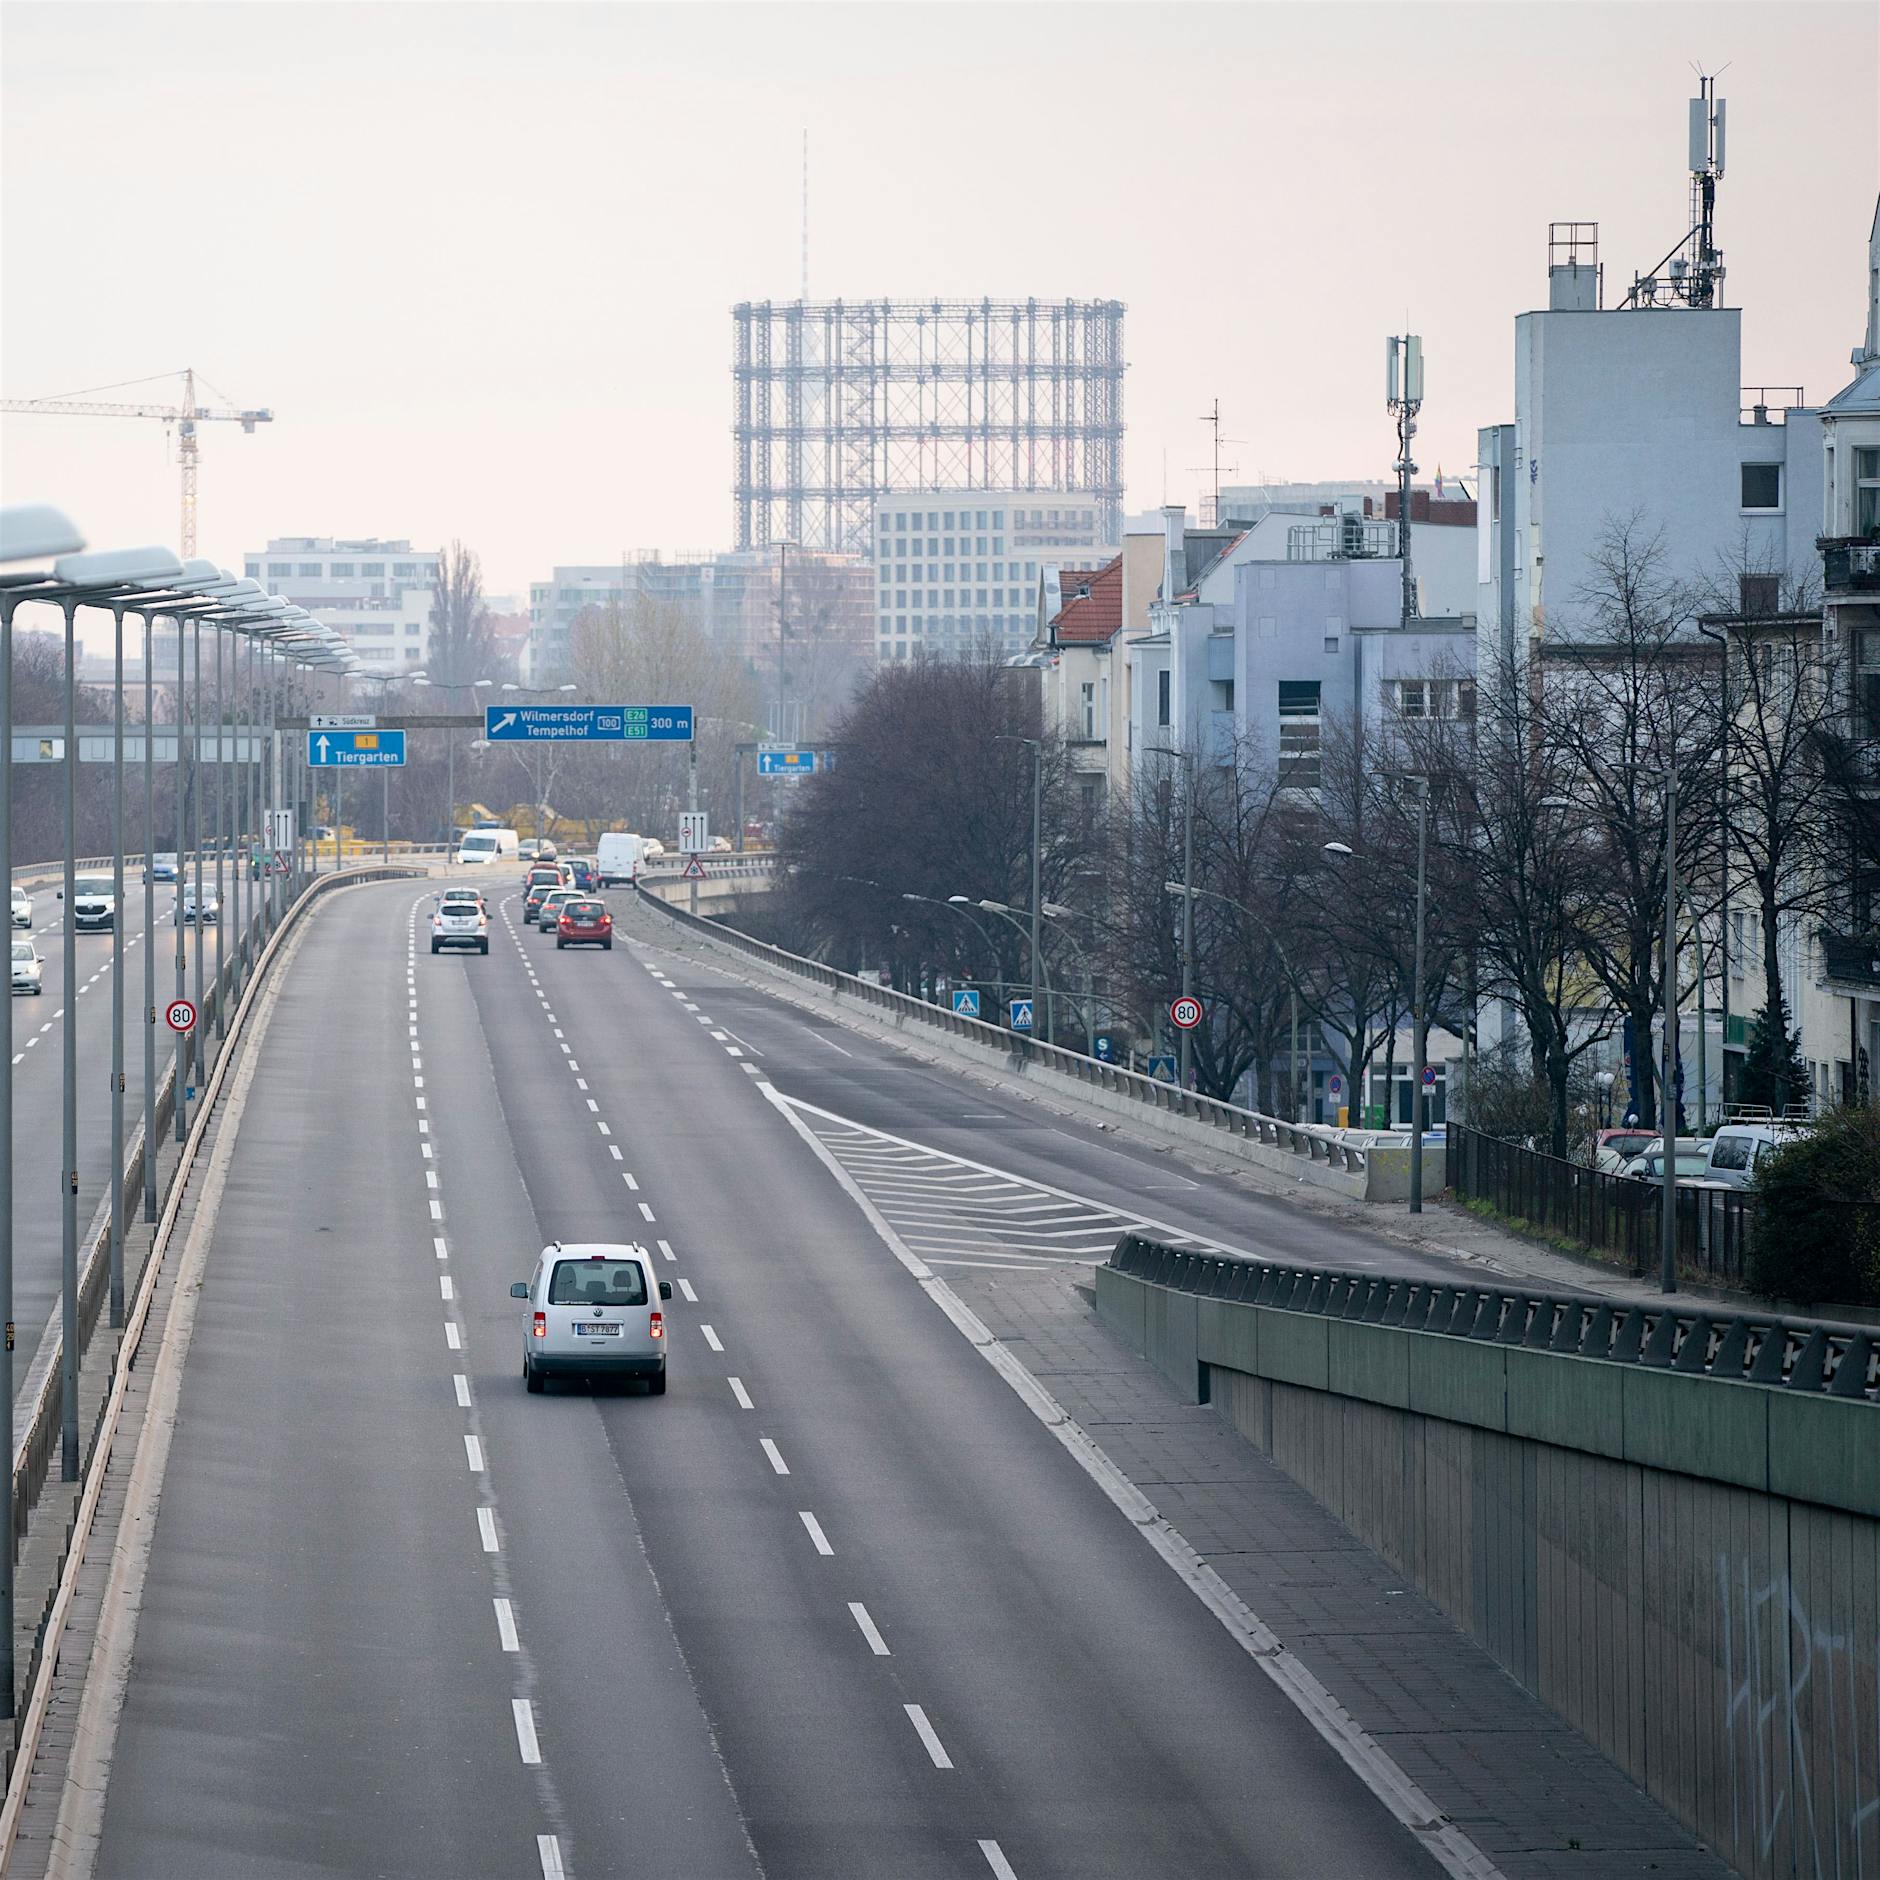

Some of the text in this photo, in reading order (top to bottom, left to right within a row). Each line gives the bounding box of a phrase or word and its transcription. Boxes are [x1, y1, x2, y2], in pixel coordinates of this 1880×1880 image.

[520, 710, 594, 722] Wilmersdorf
[627, 710, 645, 720] E26
[602, 718, 617, 728] 100
[651, 717, 688, 729] 300 m
[526, 724, 589, 738] Tempelhof
[627, 726, 644, 736] E51
[335, 751, 399, 765] Tiergarten
[172, 1008, 190, 1023] 80
[1178, 1005, 1195, 1020] 80
[1098, 1038, 1108, 1051] S
